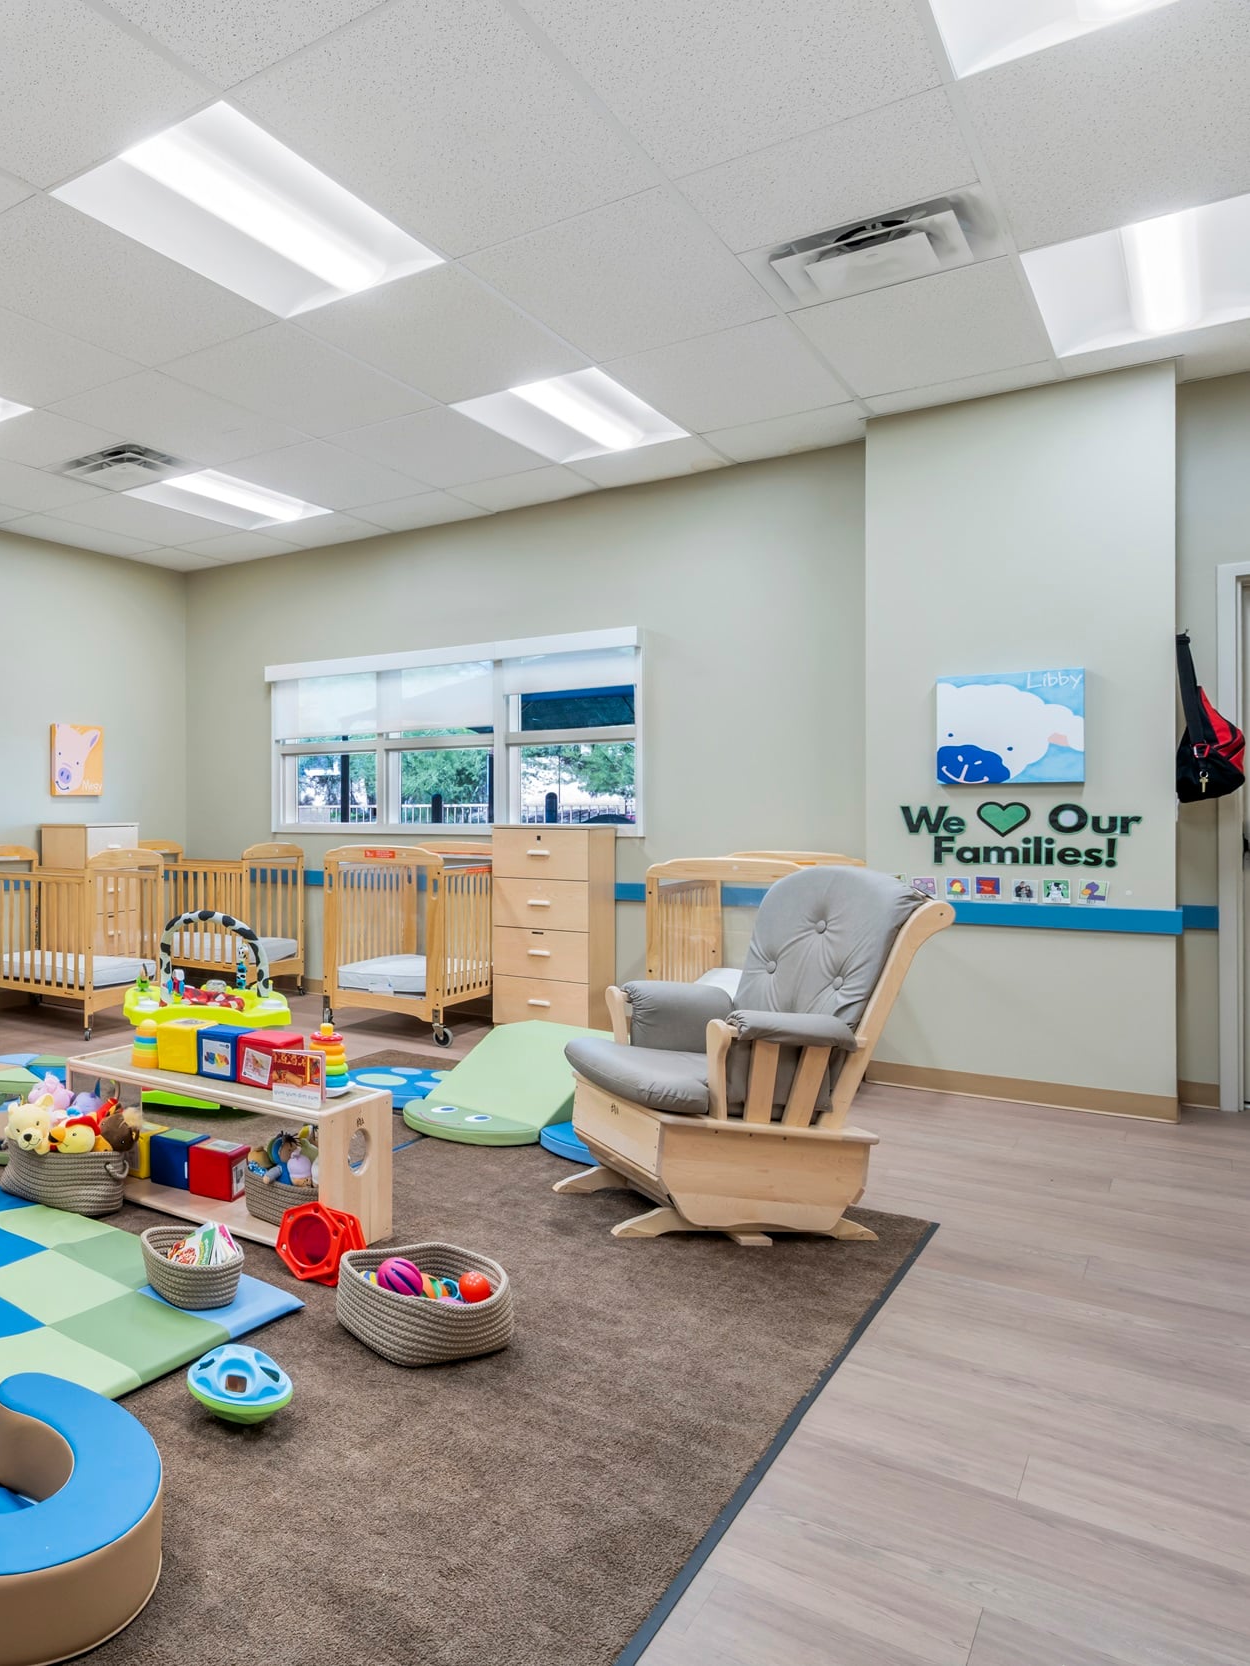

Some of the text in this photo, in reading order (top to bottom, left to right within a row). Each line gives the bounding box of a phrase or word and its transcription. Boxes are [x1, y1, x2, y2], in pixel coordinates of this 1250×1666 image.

[1026, 672, 1083, 690] Libby
[900, 803, 1143, 835] We Our
[933, 836, 1118, 868] Families!
